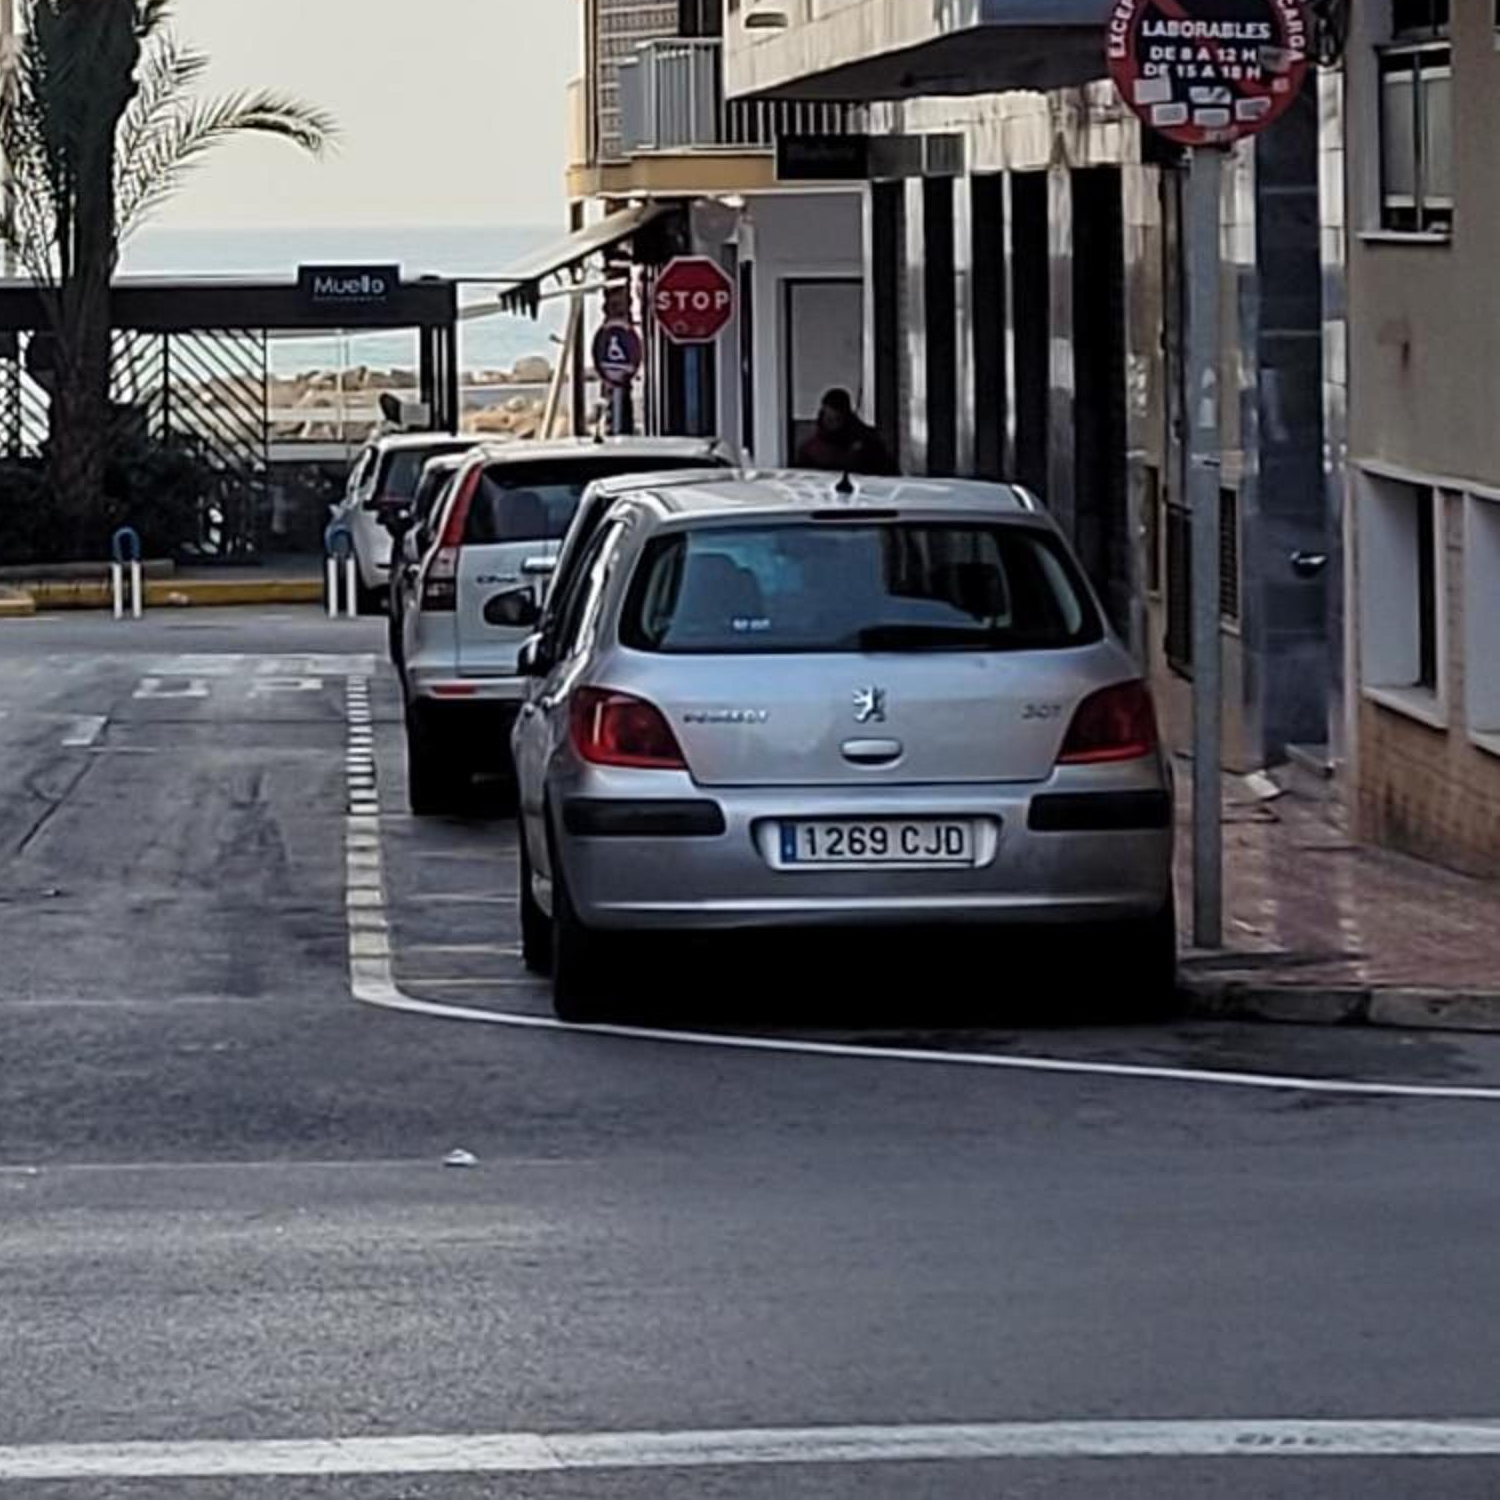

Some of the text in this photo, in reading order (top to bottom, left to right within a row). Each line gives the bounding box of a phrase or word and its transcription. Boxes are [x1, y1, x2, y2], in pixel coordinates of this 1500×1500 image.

[1141, 20, 1271, 39] LABORABLES
[1150, 46, 1176, 60] DE
[1196, 47, 1211, 61] A
[1242, 48, 1257, 62] H
[1177, 64, 1197, 78] 15
[1201, 65, 1215, 78] A
[1247, 65, 1261, 80] H
[656, 290, 729, 311] STOP
[805, 825, 964, 856] 1269 CJD
